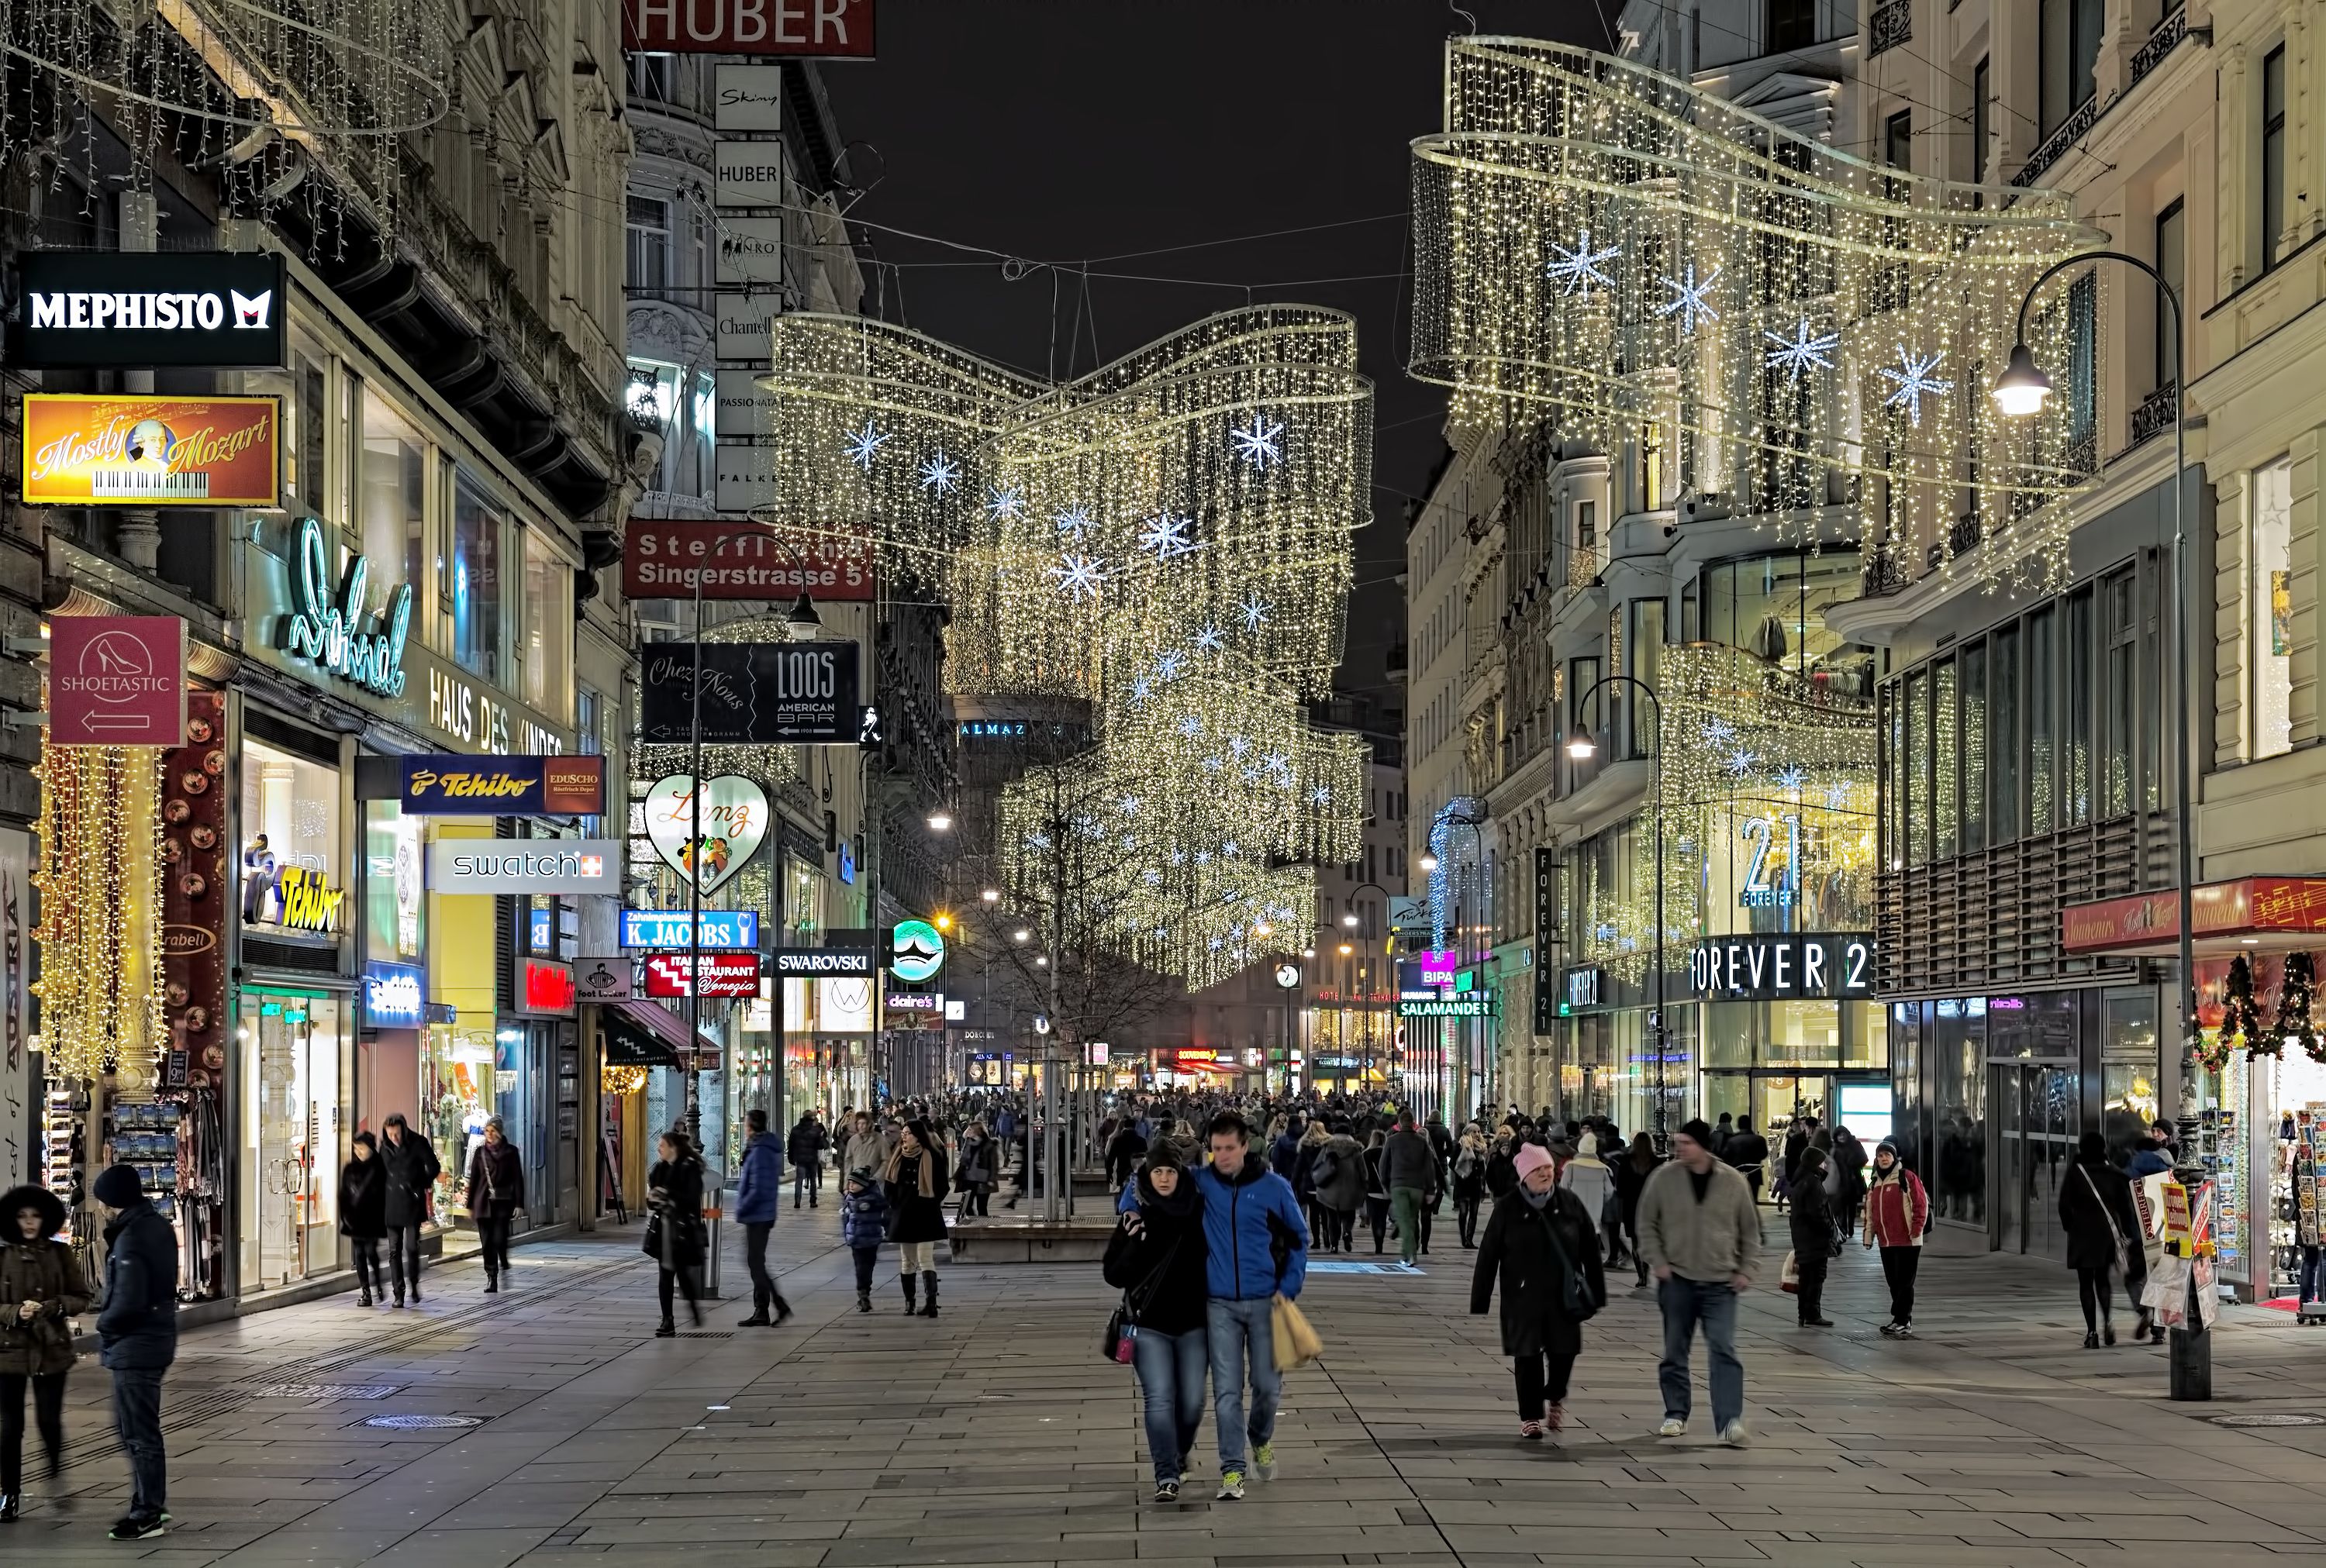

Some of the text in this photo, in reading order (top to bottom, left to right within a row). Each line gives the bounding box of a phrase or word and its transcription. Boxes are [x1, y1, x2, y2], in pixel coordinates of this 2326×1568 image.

[637, 0, 848, 44] HUBER
[720, 167, 777, 181] HUBER
[29, 292, 224, 330] MEPHISTO
[720, 398, 778, 407] PASSIONATA
[31, 415, 270, 481] Mostly Mozart
[639, 534, 764, 557] Steffl
[638, 563, 862, 589] Singerstrasse 5
[62, 677, 170, 691] SHOETASTIC
[649, 657, 744, 710] Chez Nous
[778, 651, 834, 698] LOOS
[430, 668, 471, 743] HAUS
[481, 696, 509, 756] DES
[778, 703, 835, 712] AMERICAN
[778, 714, 835, 723] BAR
[961, 724, 1023, 735] ALMAZ
[440, 774, 538, 797] Tchibo
[550, 774, 598, 784] EDUSCHO
[656, 784, 754, 839] Lnz
[453, 851, 578, 877] swatch
[1743, 815, 1798, 891] 21
[281, 866, 344, 932] Tchibo
[1744, 892, 1791, 906] FOREVER
[627, 913, 706, 923] Zahnimplantoloie
[1393, 908, 1434, 922] Türke
[627, 924, 647, 945] K.
[2065, 912, 2115, 943] Souvenirs
[164, 933, 204, 946] rabell
[1540, 856, 1548, 1030] FOREVER 21
[779, 955, 867, 970] SWAROVSKI
[1692, 943, 1877, 991] FOREVER 2
[699, 976, 756, 997] Venezia
[1424, 971, 1455, 983] BIPA
[1320, 991, 1340, 1000] HOTE
[1400, 1003, 1489, 1015] SALAMANDER
[5, 1129, 18, 1187] est
